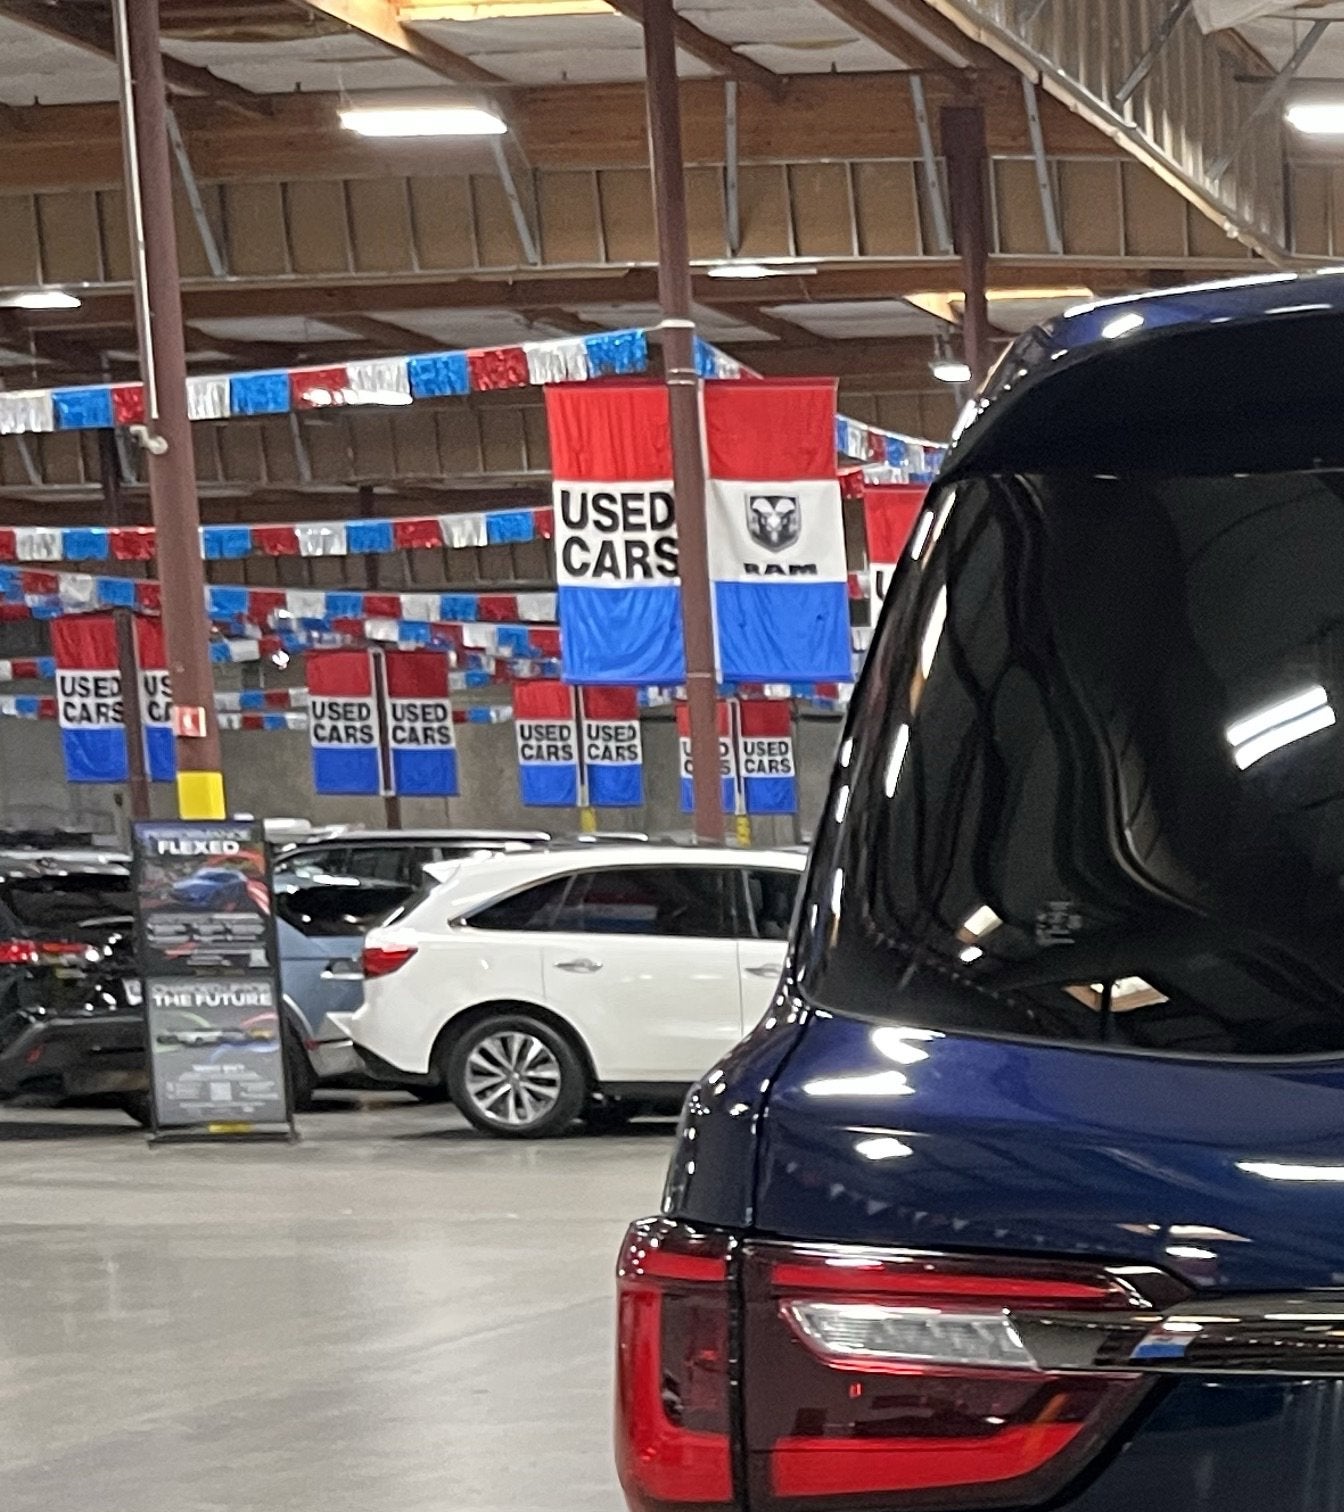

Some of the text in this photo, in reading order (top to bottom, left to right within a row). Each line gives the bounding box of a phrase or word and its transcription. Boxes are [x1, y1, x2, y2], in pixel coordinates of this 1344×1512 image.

[561, 490, 675, 533] USED
[562, 535, 679, 579] CARS
[744, 562, 818, 576] RAM
[60, 675, 122, 698] USED
[63, 701, 124, 723] CARS
[311, 701, 371, 721] USED
[391, 702, 448, 723] USED
[313, 723, 374, 744] CARS
[391, 725, 452, 745] CARS
[519, 724, 571, 742] USED
[586, 724, 637, 742] USED
[520, 743, 574, 761] CARS
[587, 743, 639, 761] CARS
[743, 741, 789, 758] USED
[744, 758, 792, 774] CARS
[157, 839, 240, 856] FLEXED
[153, 991, 273, 1008] THE FUTURE
